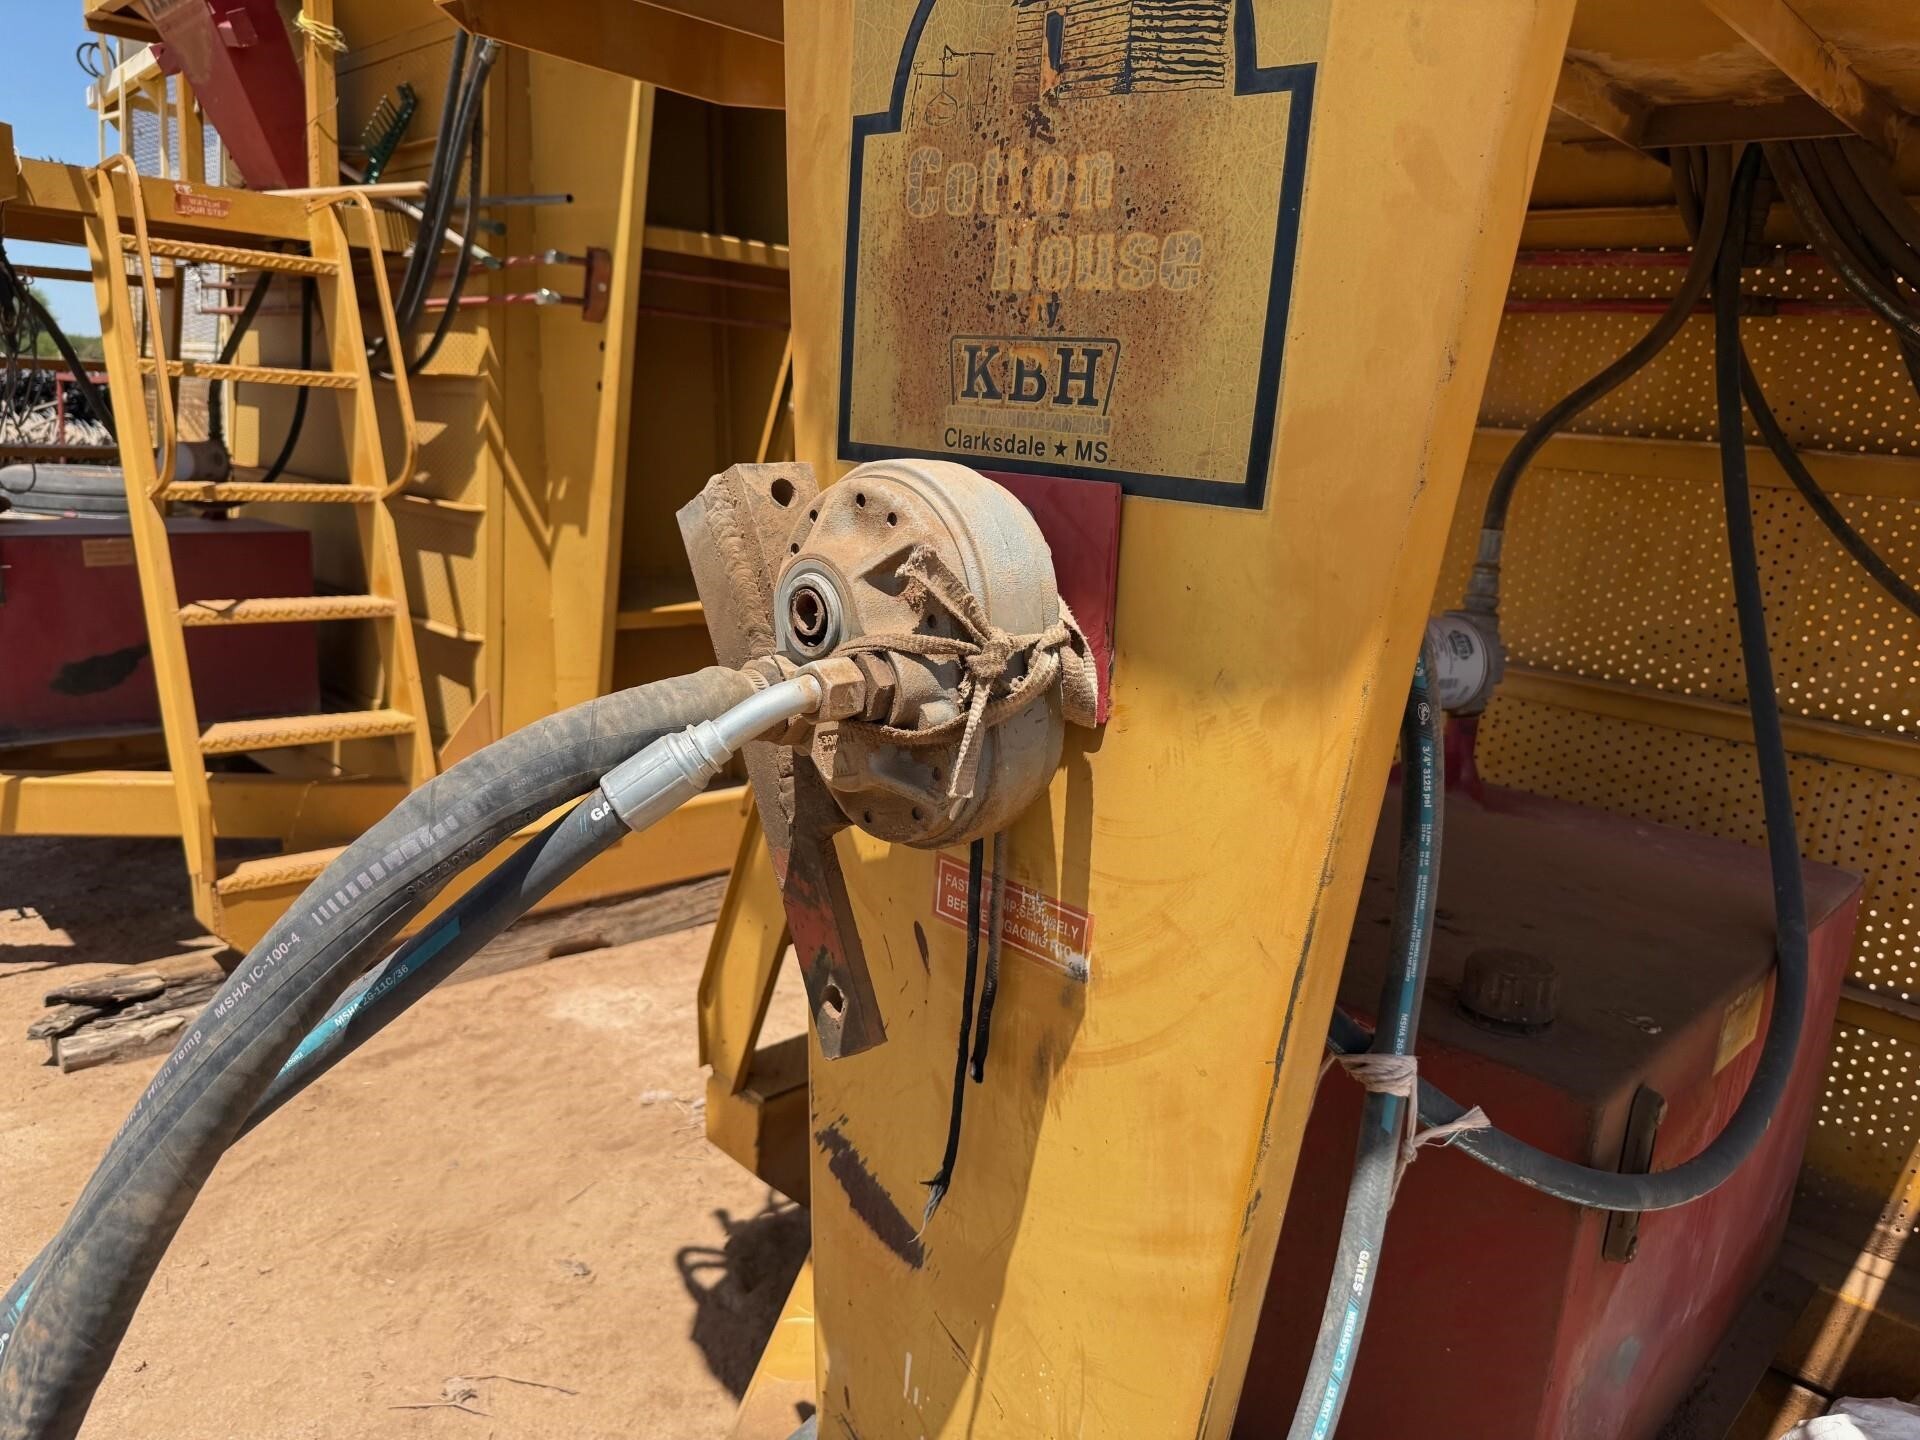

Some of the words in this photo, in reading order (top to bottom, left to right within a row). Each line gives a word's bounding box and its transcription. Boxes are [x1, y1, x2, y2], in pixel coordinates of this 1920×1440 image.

[907, 146, 1115, 219] Cotton
[992, 221, 1203, 292] House
[960, 344, 1103, 407] KBH
[944, 427, 1046, 457] Clarksdale
[1074, 439, 1108, 464] MS
[590, 800, 611, 821] GA
[946, 894, 988, 923] BEFE
[1004, 919, 1049, 949] GAGING
[214, 981, 251, 1019] MSHA
[334, 1002, 360, 1027] MSHA
[362, 964, 409, 1006] 2G-11C/36
[1398, 1012, 1408, 1037] MSHA
[172, 1029, 202, 1065] Temp
[1395, 1037, 1404, 1056] 2G-1
